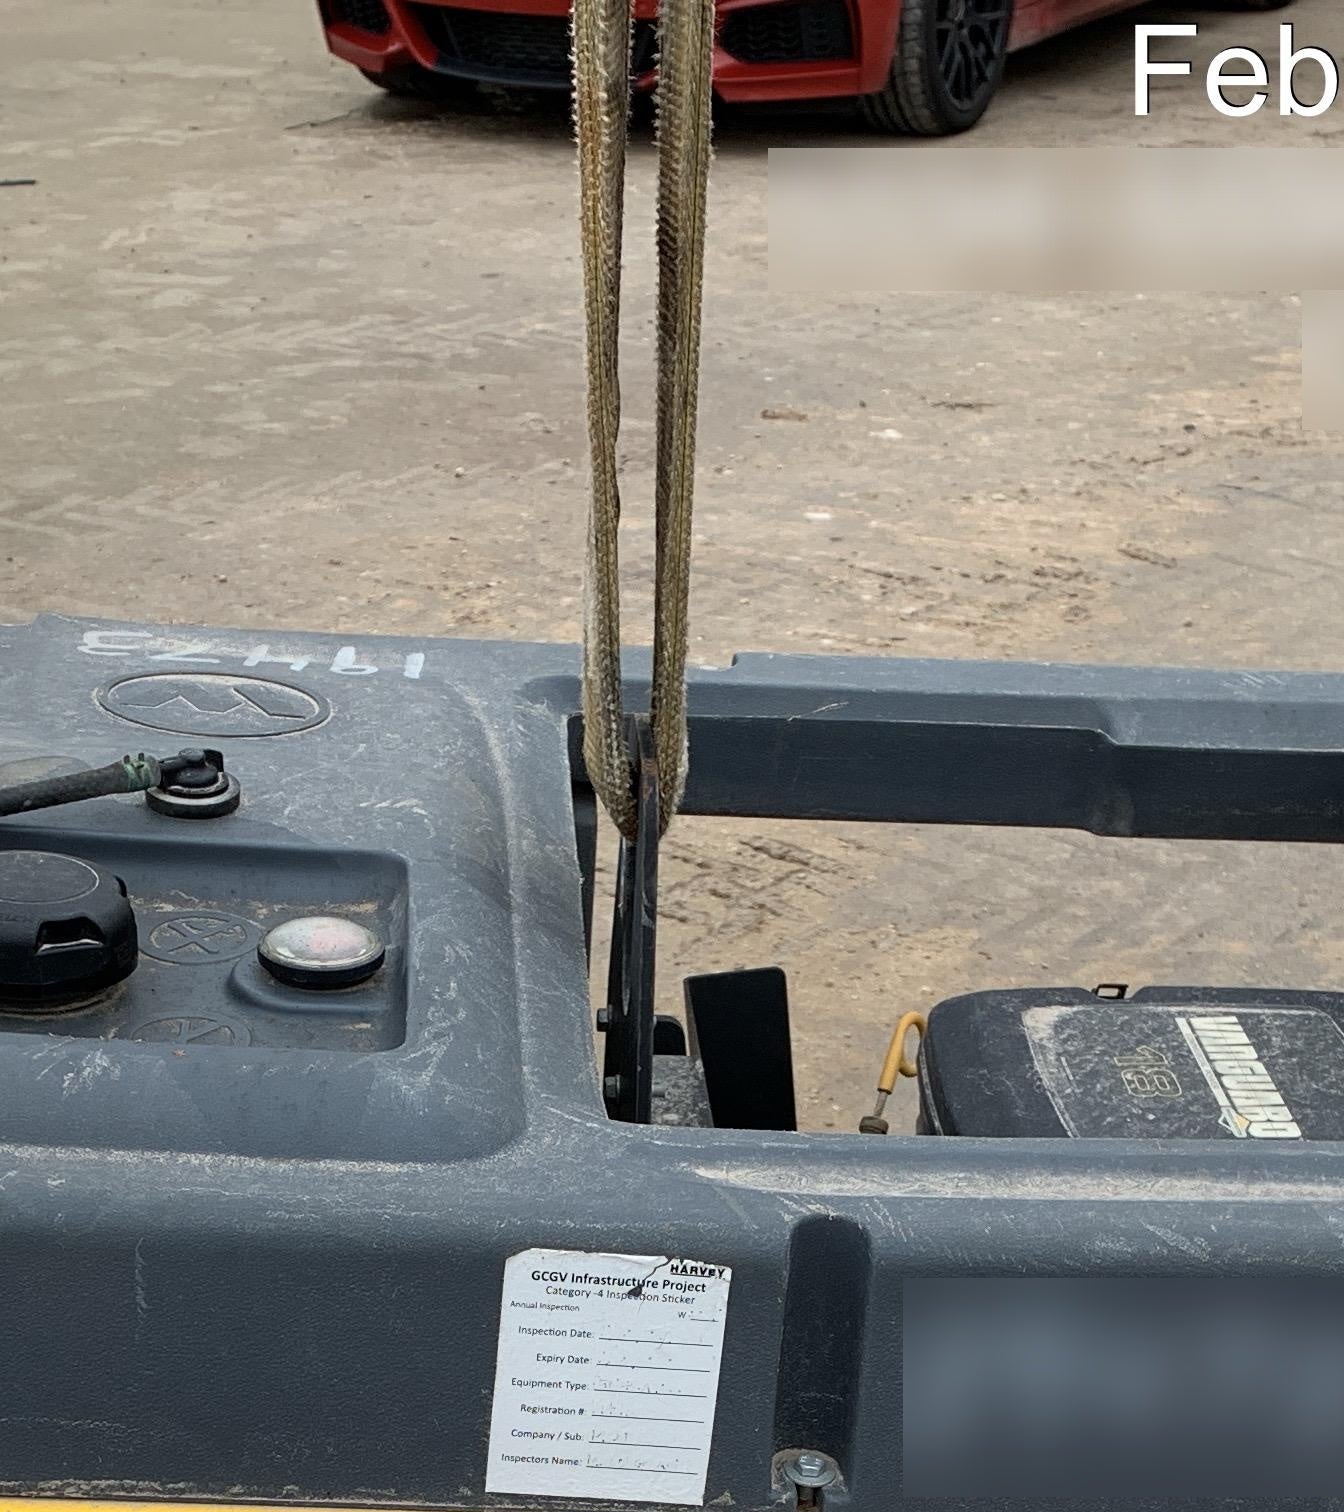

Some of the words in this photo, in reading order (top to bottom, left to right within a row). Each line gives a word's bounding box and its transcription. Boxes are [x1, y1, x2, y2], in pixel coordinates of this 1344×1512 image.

[1189, 1016, 1303, 1139] VANGUARD
[531, 1270, 568, 1284] GCGV
[571, 1272, 659, 1289] Infrastructure
[662, 1279, 706, 1294] Project
[545, 1285, 591, 1299] Category
[661, 1293, 696, 1305] Sticker
[510, 1300, 538, 1310] Annual
[539, 1302, 580, 1313] Inspection
[518, 1325, 567, 1338] Inspection
[536, 1353, 564, 1366] Expiry
[511, 1377, 564, 1391] Equipment
[520, 1404, 577, 1416] Registration
[511, 1429, 555, 1442] Company
[501, 1453, 549, 1466] Inspectors
